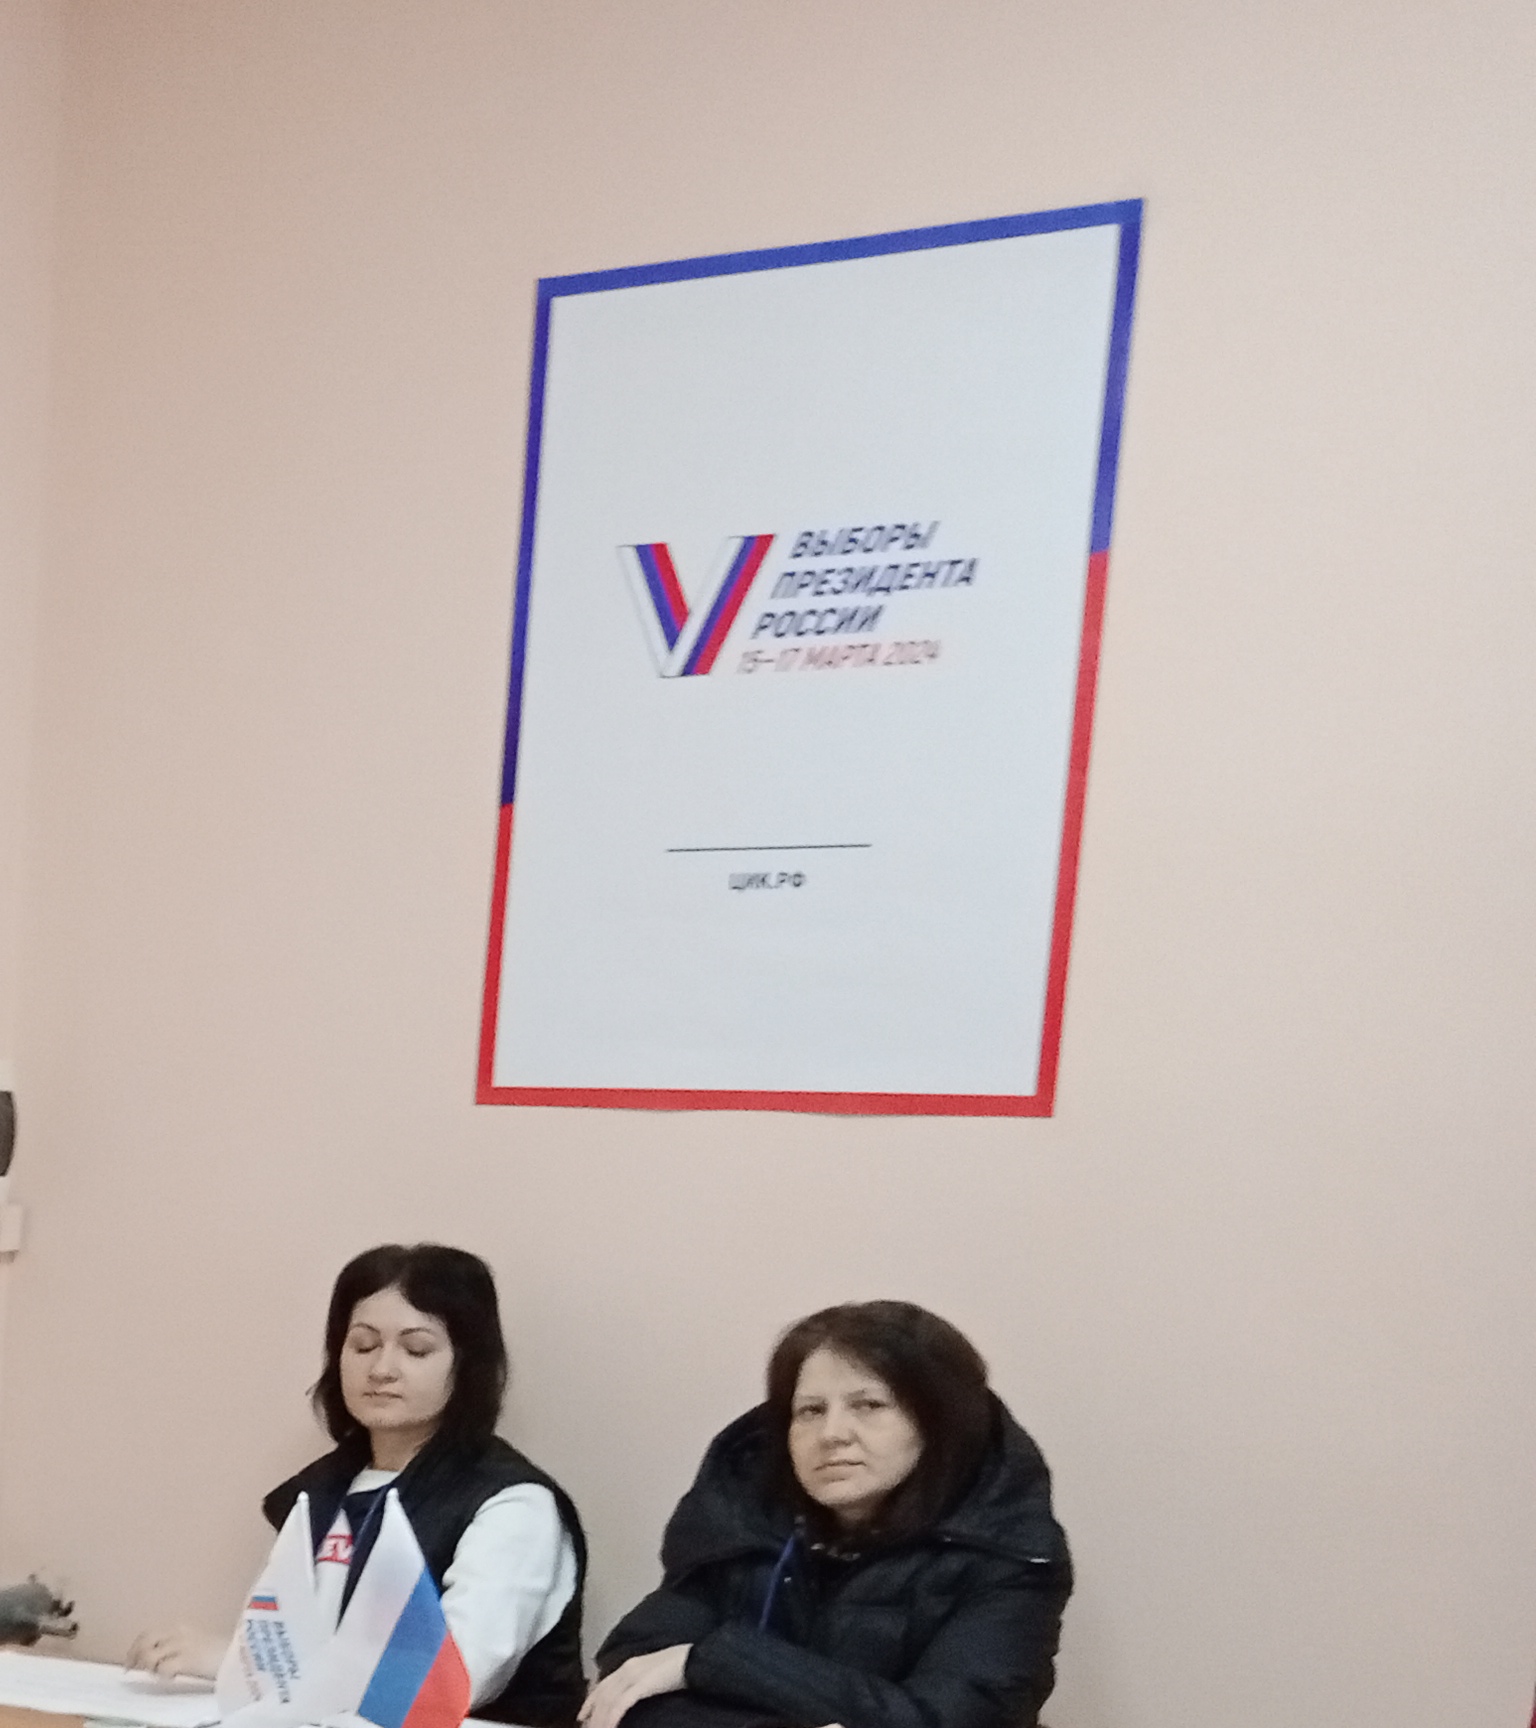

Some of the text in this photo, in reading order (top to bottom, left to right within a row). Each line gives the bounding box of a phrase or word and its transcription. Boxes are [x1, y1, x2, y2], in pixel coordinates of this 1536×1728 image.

[789, 520, 941, 560] ВЫБОРЫ
[770, 557, 980, 601] ПРЕЗИДЕНТА
[749, 604, 885, 640] РОССИИ
[798, 642, 880, 672] МАРТА
[883, 639, 942, 667] 2024
[729, 872, 807, 892] ЦИК.РФ
